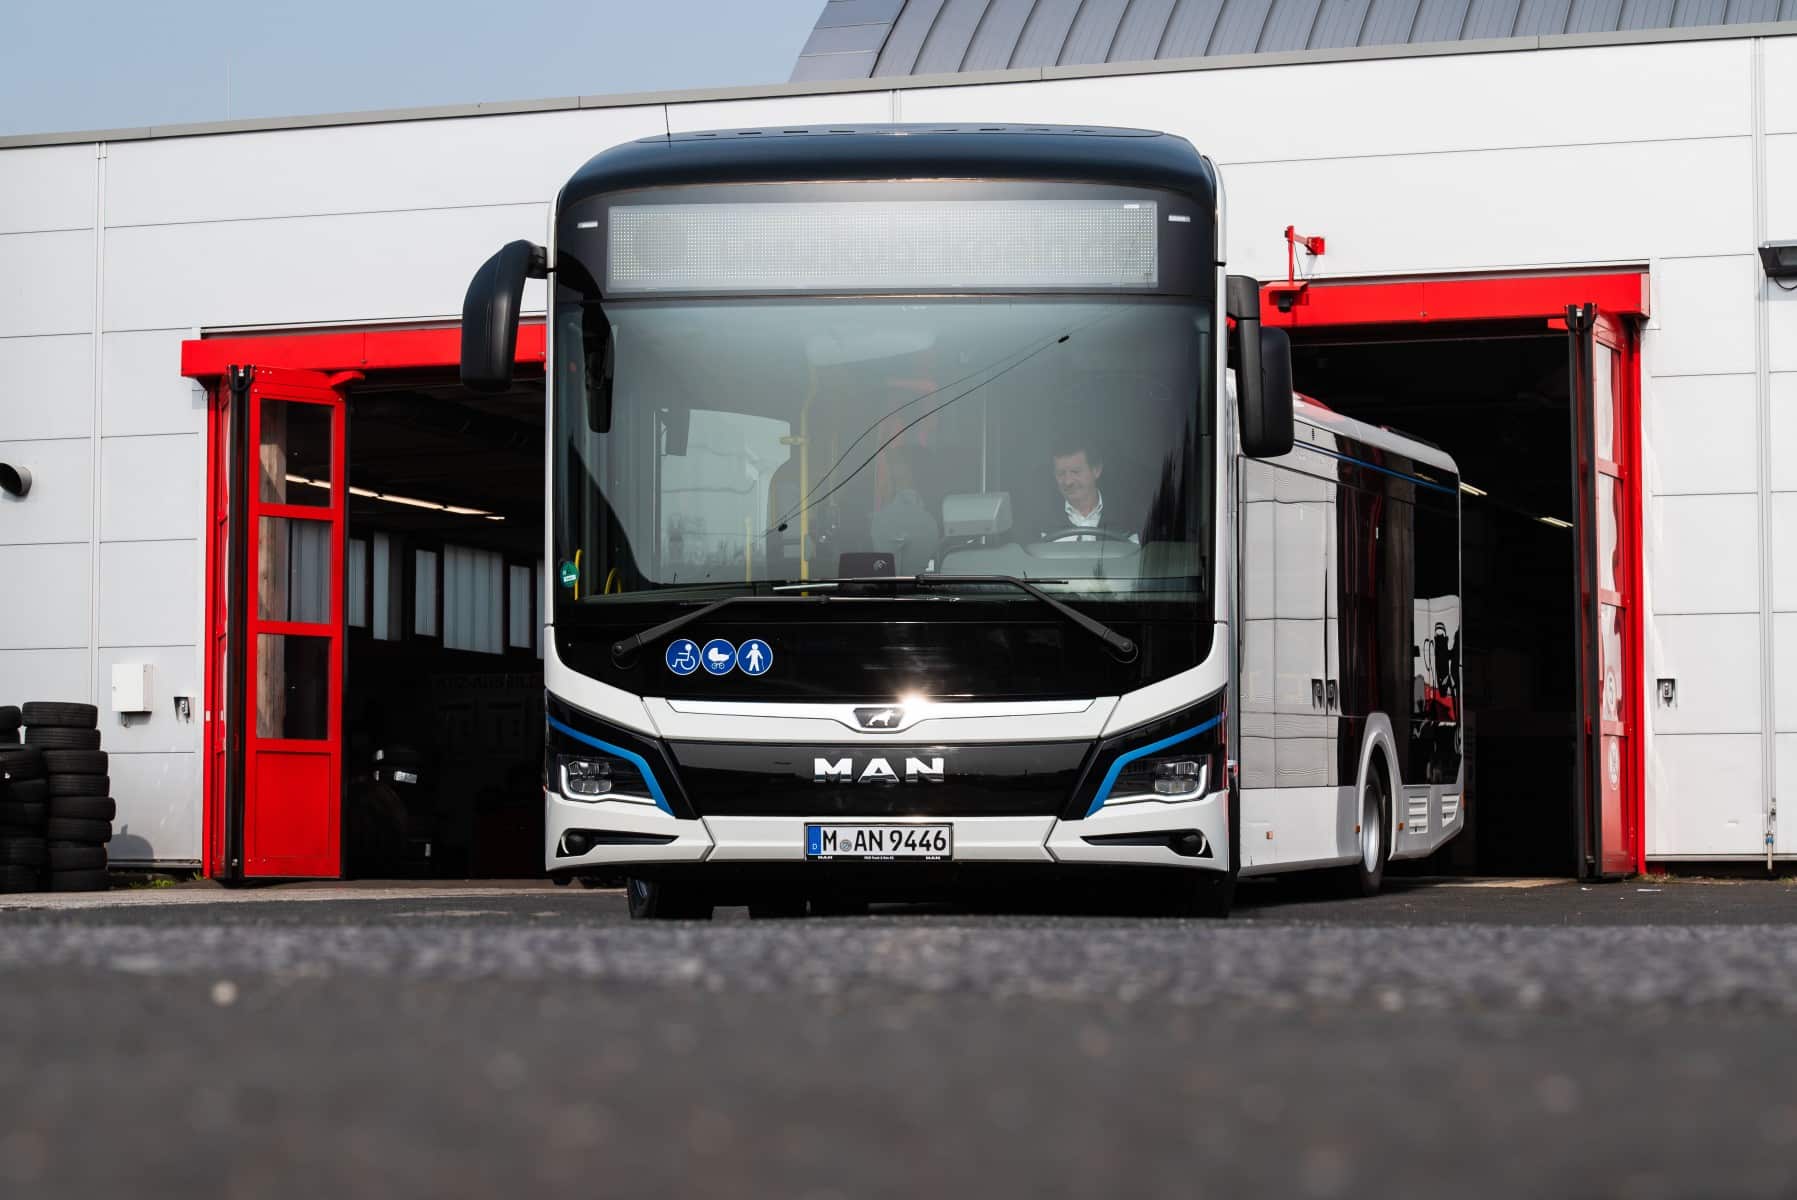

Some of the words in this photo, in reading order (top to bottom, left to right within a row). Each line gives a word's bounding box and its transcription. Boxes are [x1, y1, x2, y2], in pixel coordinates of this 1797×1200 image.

[813, 757, 945, 783] MAN
[822, 830, 837, 852] M
[854, 830, 883, 852] AN
[889, 830, 947, 852] 9446
